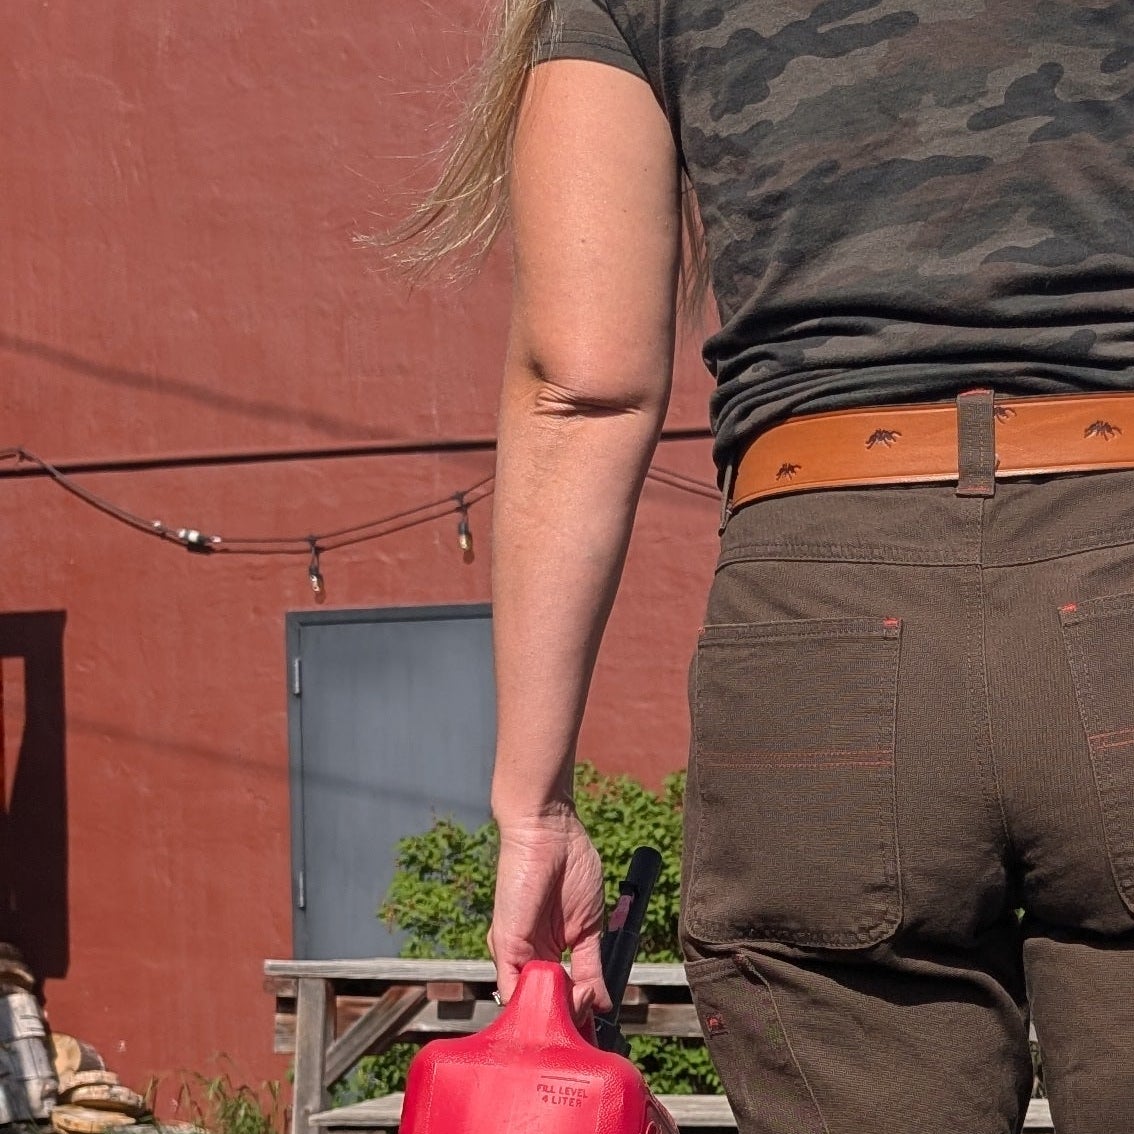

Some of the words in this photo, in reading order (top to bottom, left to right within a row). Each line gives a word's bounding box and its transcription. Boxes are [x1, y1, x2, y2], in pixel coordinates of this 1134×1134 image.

[536, 1084, 556, 1094] FILL
[559, 1086, 588, 1098] LEVEL
[551, 1096, 582, 1107] LITER
